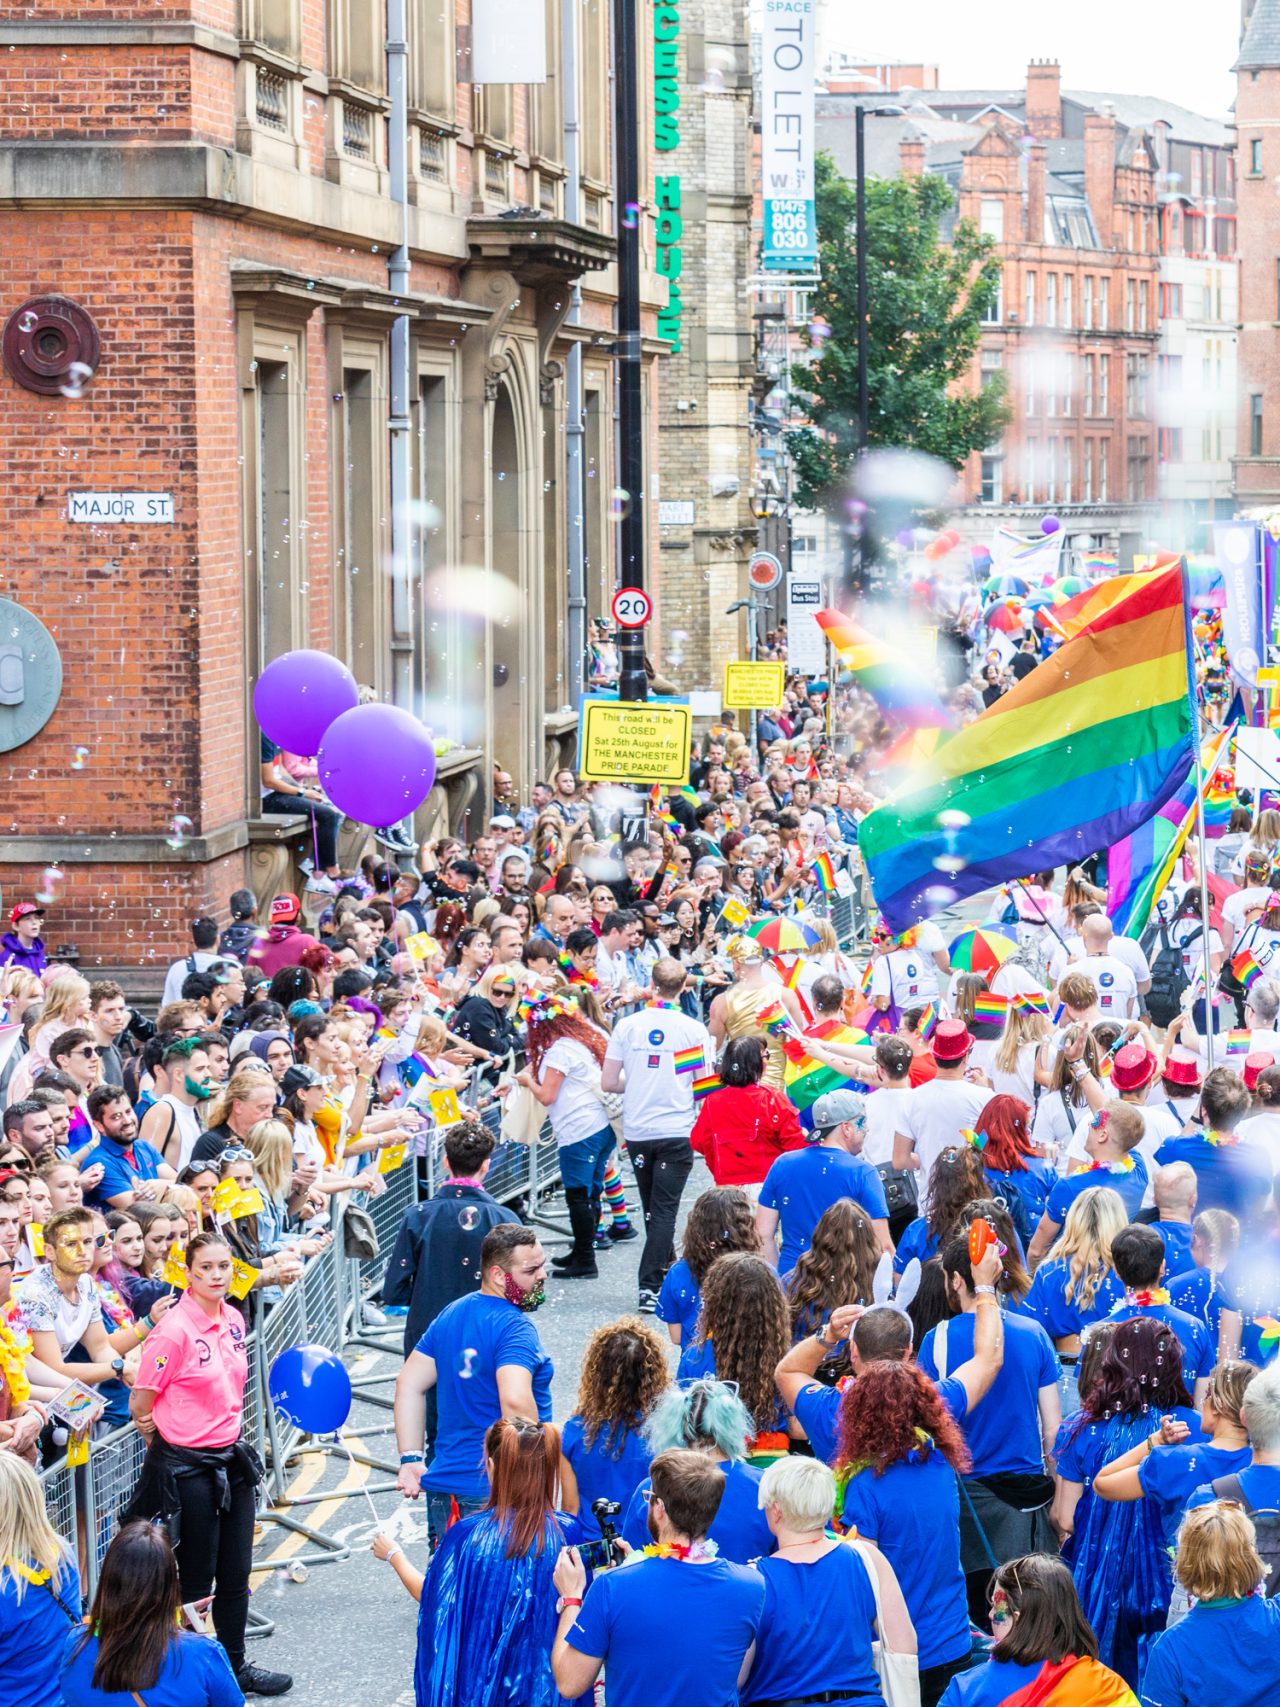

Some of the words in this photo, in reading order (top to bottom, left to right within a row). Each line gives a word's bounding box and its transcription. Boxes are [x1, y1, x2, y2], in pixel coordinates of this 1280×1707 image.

[767, 2, 812, 13] SPACE
[774, 19, 803, 71] TO
[774, 91, 802, 162] LET
[771, 200, 806, 213] 01475
[772, 214, 807, 231] 806
[772, 231, 808, 249] 030
[73, 500, 135, 516] MAJOR
[147, 499, 169, 516] ST.
[619, 600, 646, 615] 20
[603, 713, 620, 722] This
[622, 713, 643, 723] road
[663, 715, 673, 725] be
[618, 726, 656, 735] CLOSED
[594, 737, 609, 746] Sat
[611, 737, 630, 747] 25th
[632, 739, 664, 750] August
[665, 740, 678, 749] for
[594, 749, 611, 758] THE
[614, 750, 678, 760] MANCHESTER
[601, 762, 629, 771] PRIDE
[632, 763, 669, 773] PARADE
